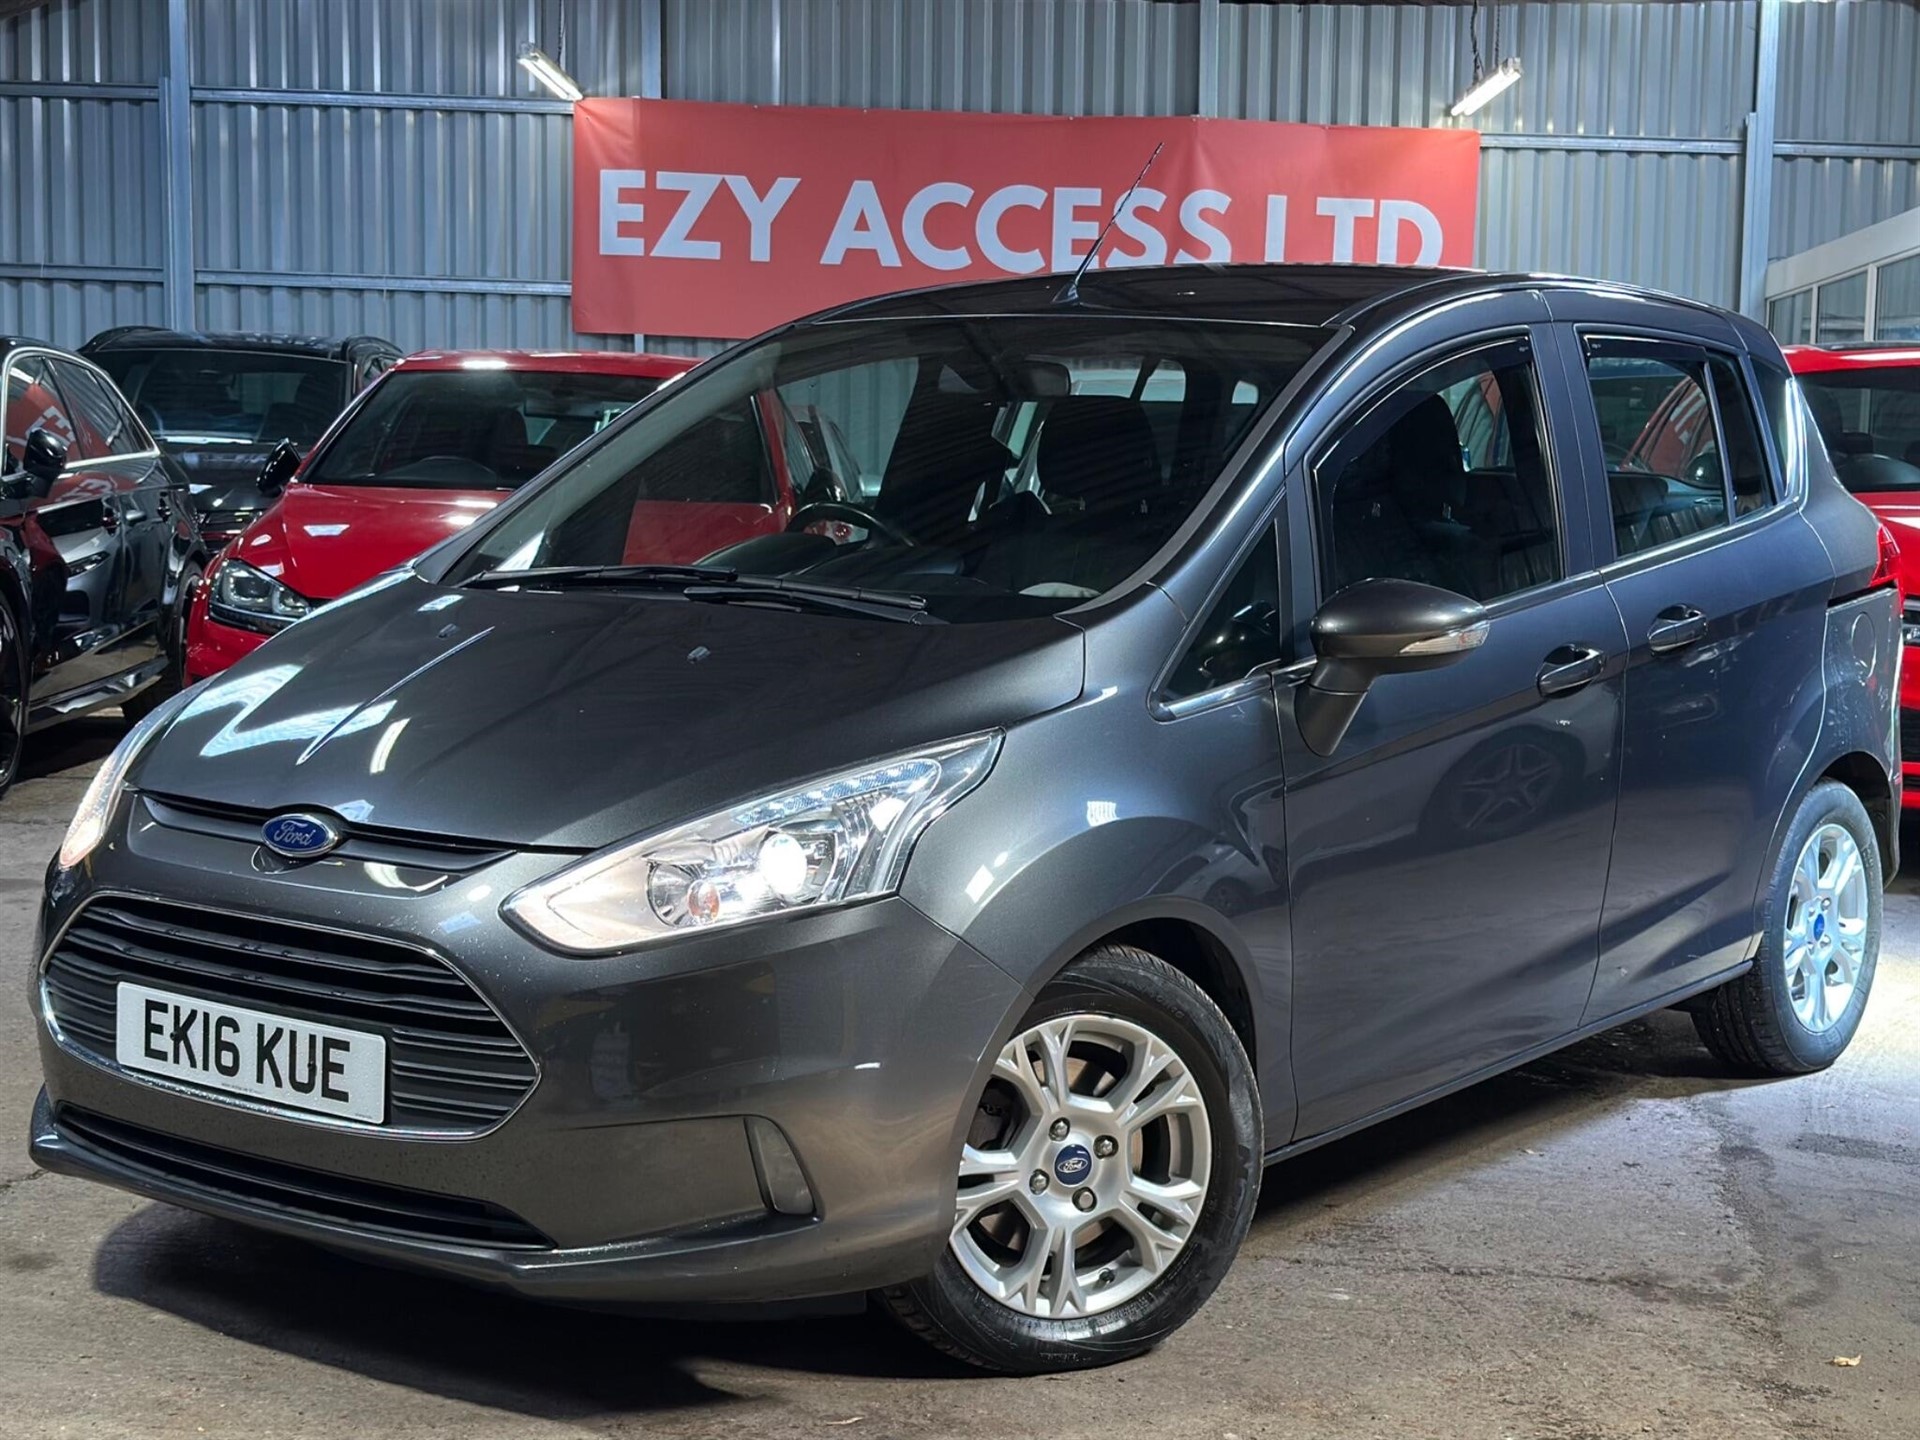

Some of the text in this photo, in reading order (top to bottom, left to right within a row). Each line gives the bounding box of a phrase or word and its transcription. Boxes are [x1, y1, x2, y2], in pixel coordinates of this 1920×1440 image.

[599, 169, 801, 262] EZY
[820, 180, 1232, 274] ACCESS
[273, 820, 316, 846] Ford
[144, 999, 350, 1103] EK16 KUE
